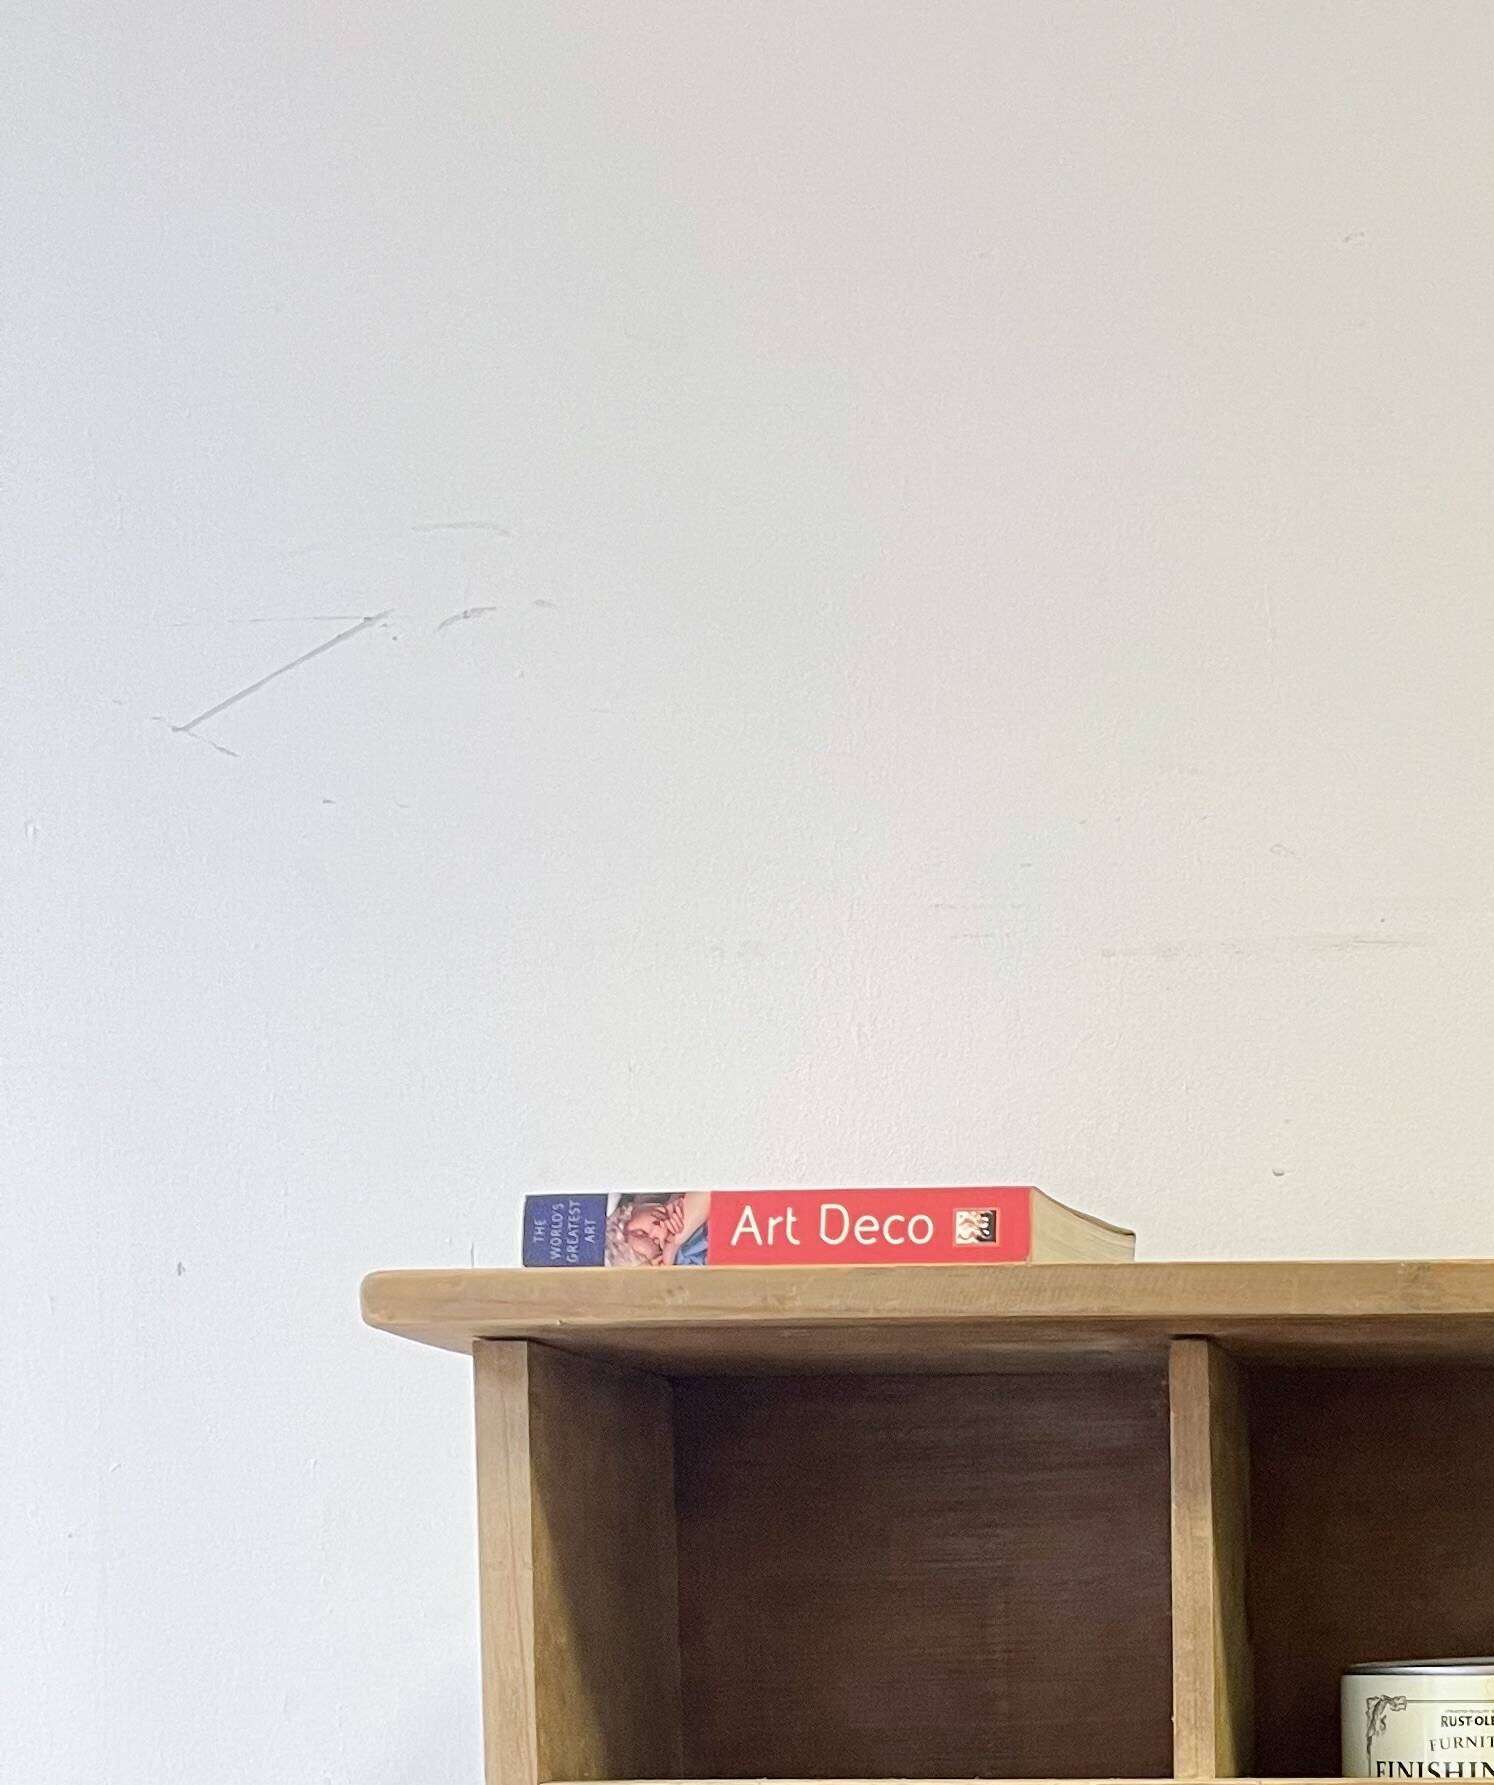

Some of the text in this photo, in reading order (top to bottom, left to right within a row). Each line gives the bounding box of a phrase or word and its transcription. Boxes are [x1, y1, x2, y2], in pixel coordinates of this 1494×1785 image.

[533, 1219, 547, 1243] THE
[549, 1202, 565, 1260] WORLD'S
[566, 1200, 581, 1263] GREATEST
[584, 1218, 597, 1244] ART
[731, 1203, 934, 1246] Art Deco
